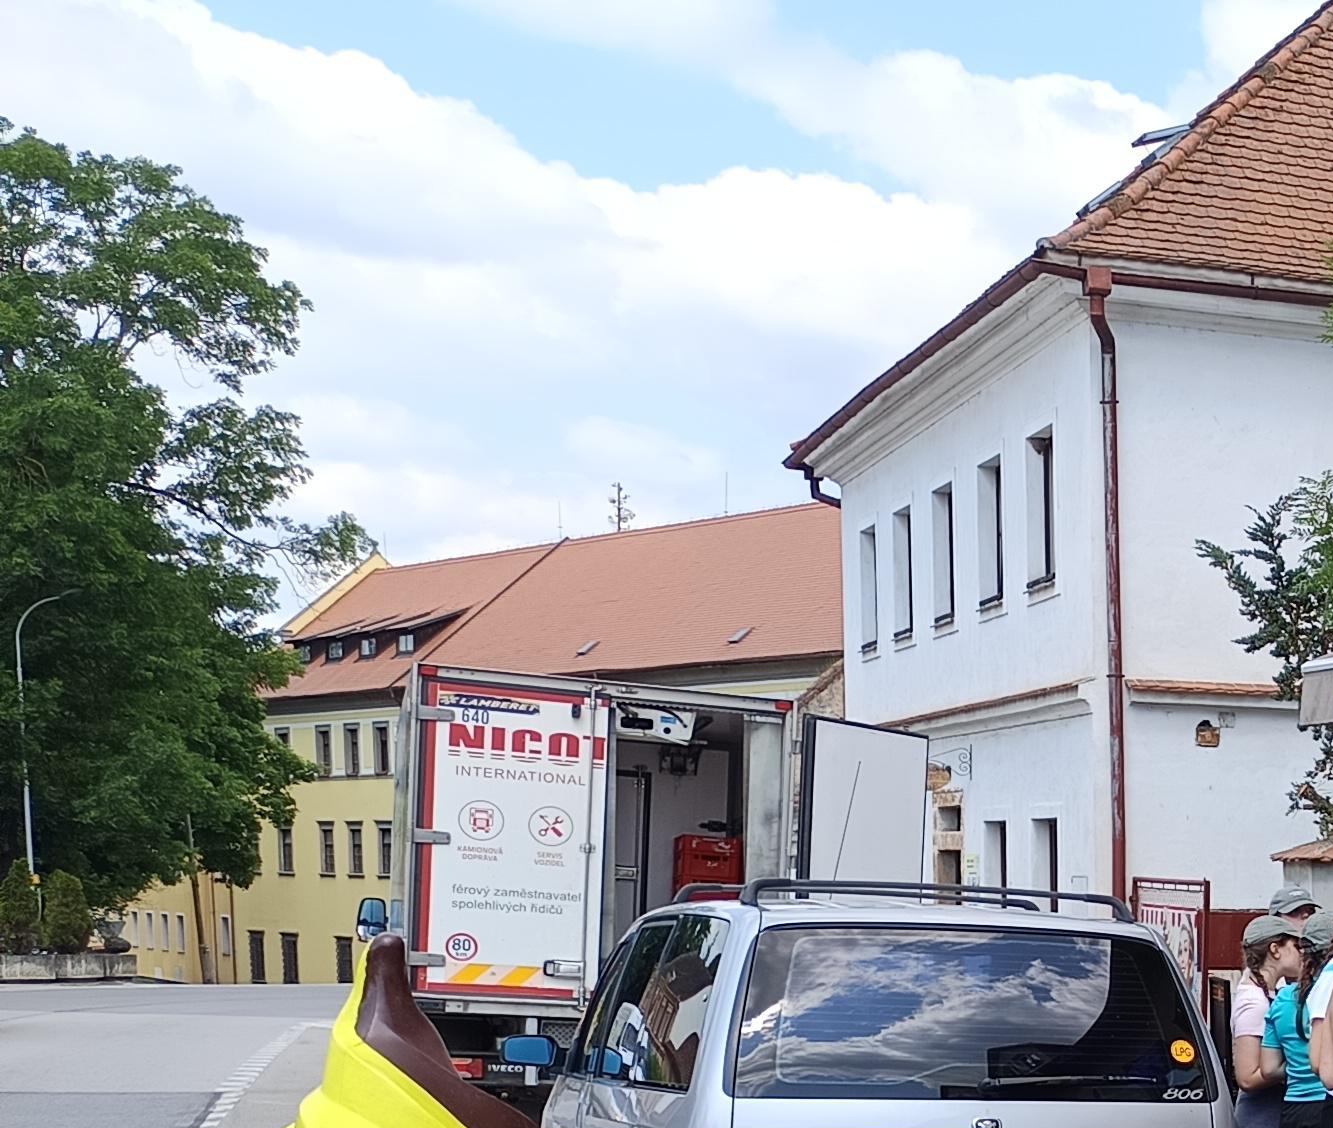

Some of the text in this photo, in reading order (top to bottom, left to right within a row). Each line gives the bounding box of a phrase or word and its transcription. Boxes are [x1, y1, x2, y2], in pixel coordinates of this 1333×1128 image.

[461, 709, 490, 725] 640
[455, 765, 586, 786] INTERNATIONAL
[536, 851, 563, 860] SERVIS
[534, 859, 566, 868] VOZIDEL
[452, 884, 582, 903] férový zaměstnavatel
[451, 899, 563, 915] spolehlivých řidičů
[452, 938, 472, 952] 80
[1174, 1046, 1192, 1057] LPG
[1162, 1087, 1205, 1100] 806
